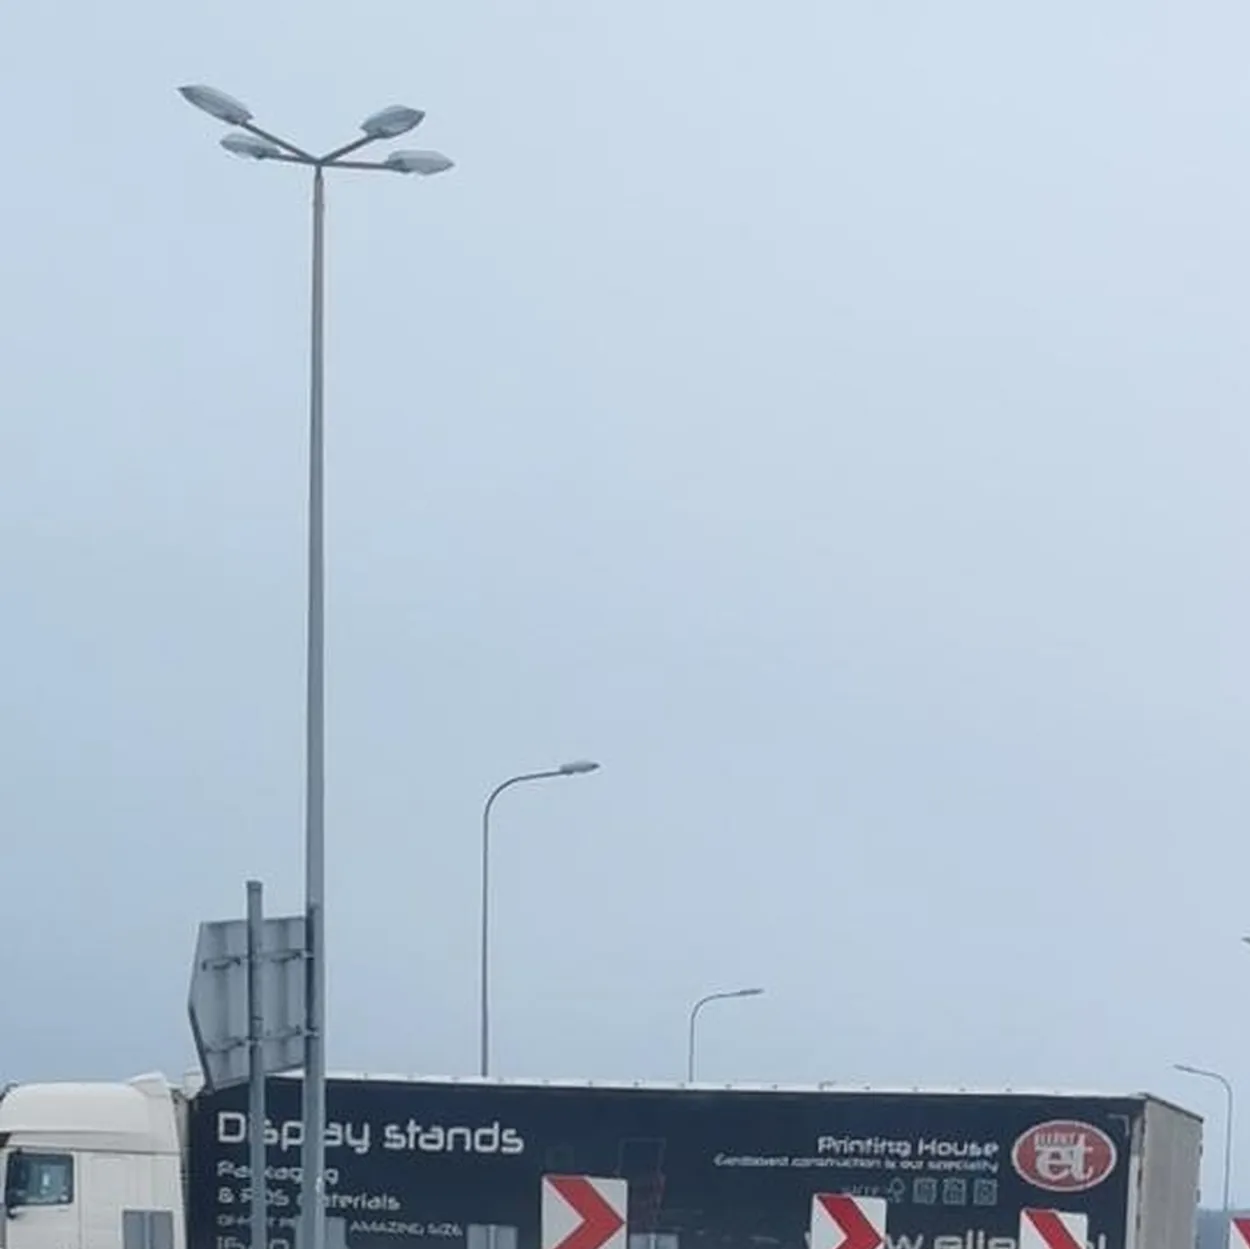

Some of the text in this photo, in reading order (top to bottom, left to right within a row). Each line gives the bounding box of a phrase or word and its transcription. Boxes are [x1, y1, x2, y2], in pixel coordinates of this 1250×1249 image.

[218, 1111, 525, 1154] Dspay stands
[818, 1136, 1000, 1157] Printing House
